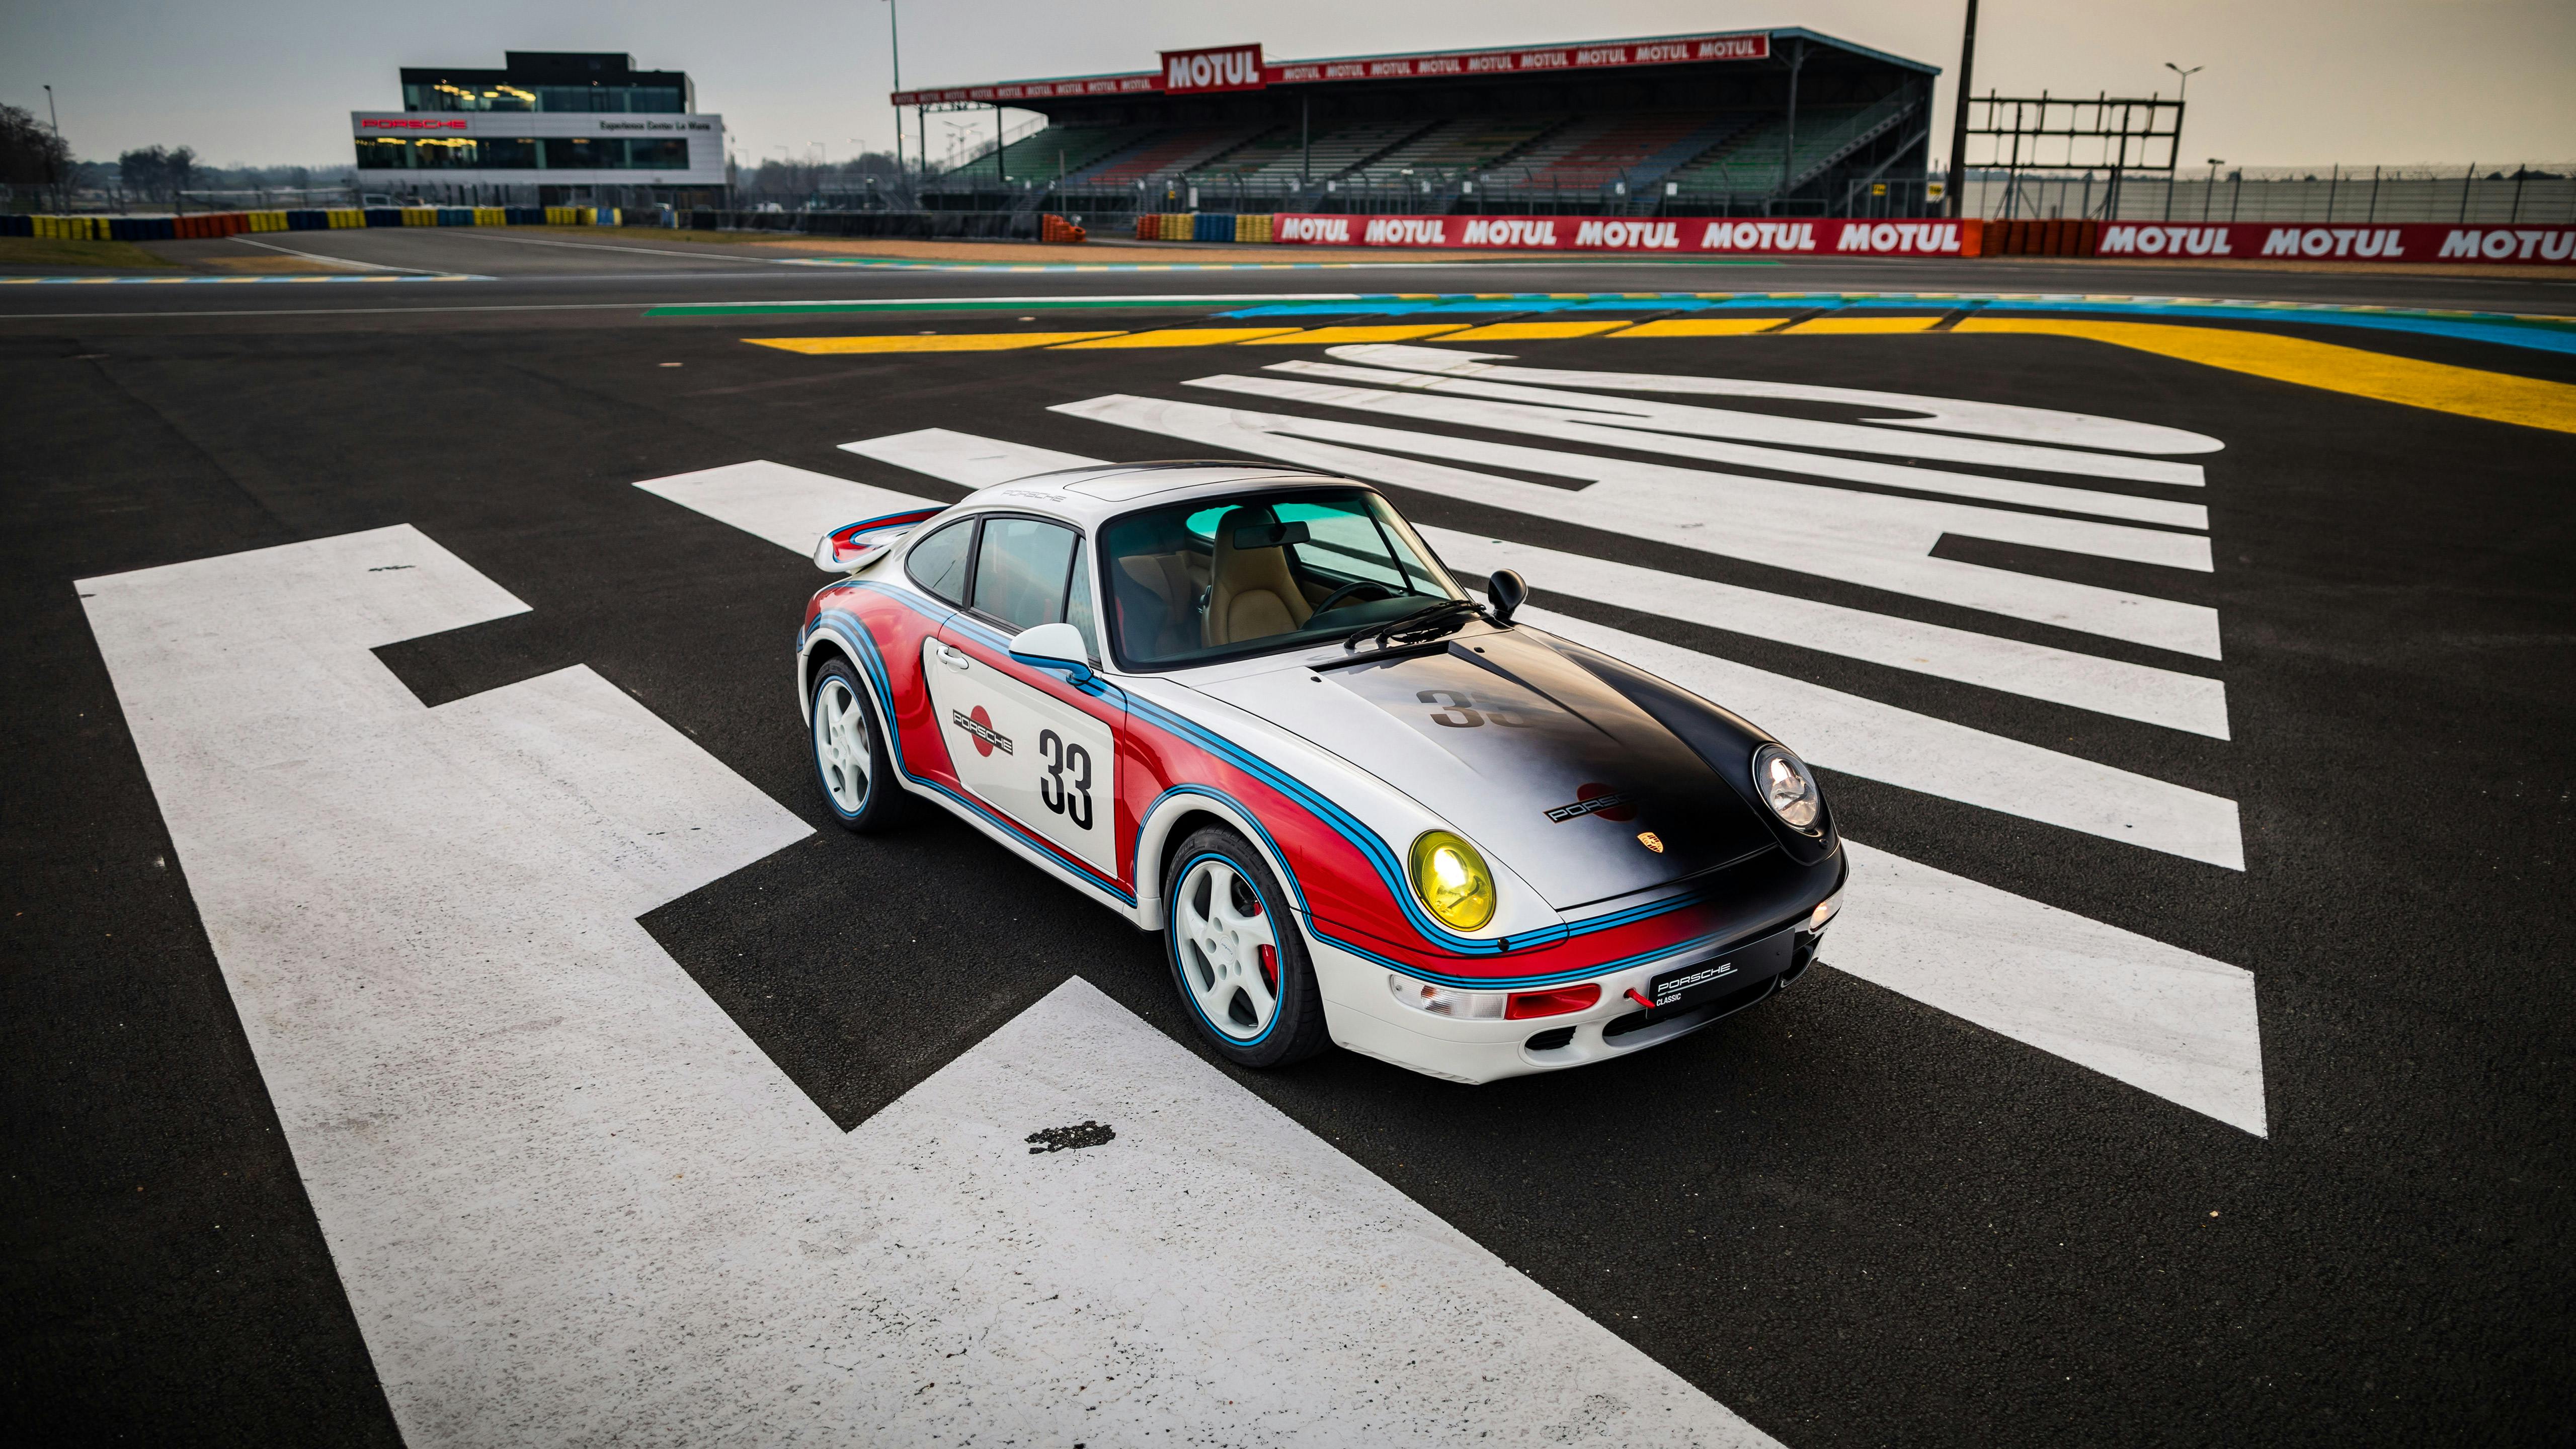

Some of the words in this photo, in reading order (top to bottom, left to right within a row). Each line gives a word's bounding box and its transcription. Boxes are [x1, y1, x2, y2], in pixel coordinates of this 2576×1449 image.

[1167, 51, 1260, 89] MOTUL
[1284, 66, 1321, 80] MOTUL
[1326, 64, 1365, 77] MOTUL
[1371, 61, 1412, 75] MOTUL
[1418, 58, 1462, 73] MOTUL
[1467, 56, 1513, 71] MOTUL
[1520, 51, 1569, 68] MOTUL
[1577, 48, 1628, 65] MOTUL
[1636, 44, 1690, 61] MOTUL
[1698, 39, 1757, 57] MOTUL
[1026, 85, 1053, 96] MOTUL
[1057, 83, 1084, 94] MOTUL
[1088, 81, 1117, 92] MOTUL
[1121, 78, 1152, 90] MOTUL
[362, 119, 467, 129] PORSCHE
[599, 121, 645, 132] Experience
[646, 121, 674, 130] Center
[1281, 217, 1350, 242] MOTUL
[1364, 219, 1446, 245] MOTUL
[1462, 220, 1558, 246] MOTUL
[1574, 220, 1679, 249] MOTUL
[1702, 222, 1817, 252] MOTUL
[1836, 223, 1962, 253] MOTUL
[2100, 225, 2232, 255] MOTUL
[2261, 228, 2406, 258] MOTUL
[2437, 229, 2576, 261] MOTU
[1000, 490, 1067, 502] PORSCHE
[1416, 690, 1539, 729] 33
[953, 712, 1012, 753] PORSCHE
[1039, 729, 1093, 831] 33
[1658, 962, 1731, 993] PORSCHE
[1656, 993, 1681, 1006] CLASSIC
